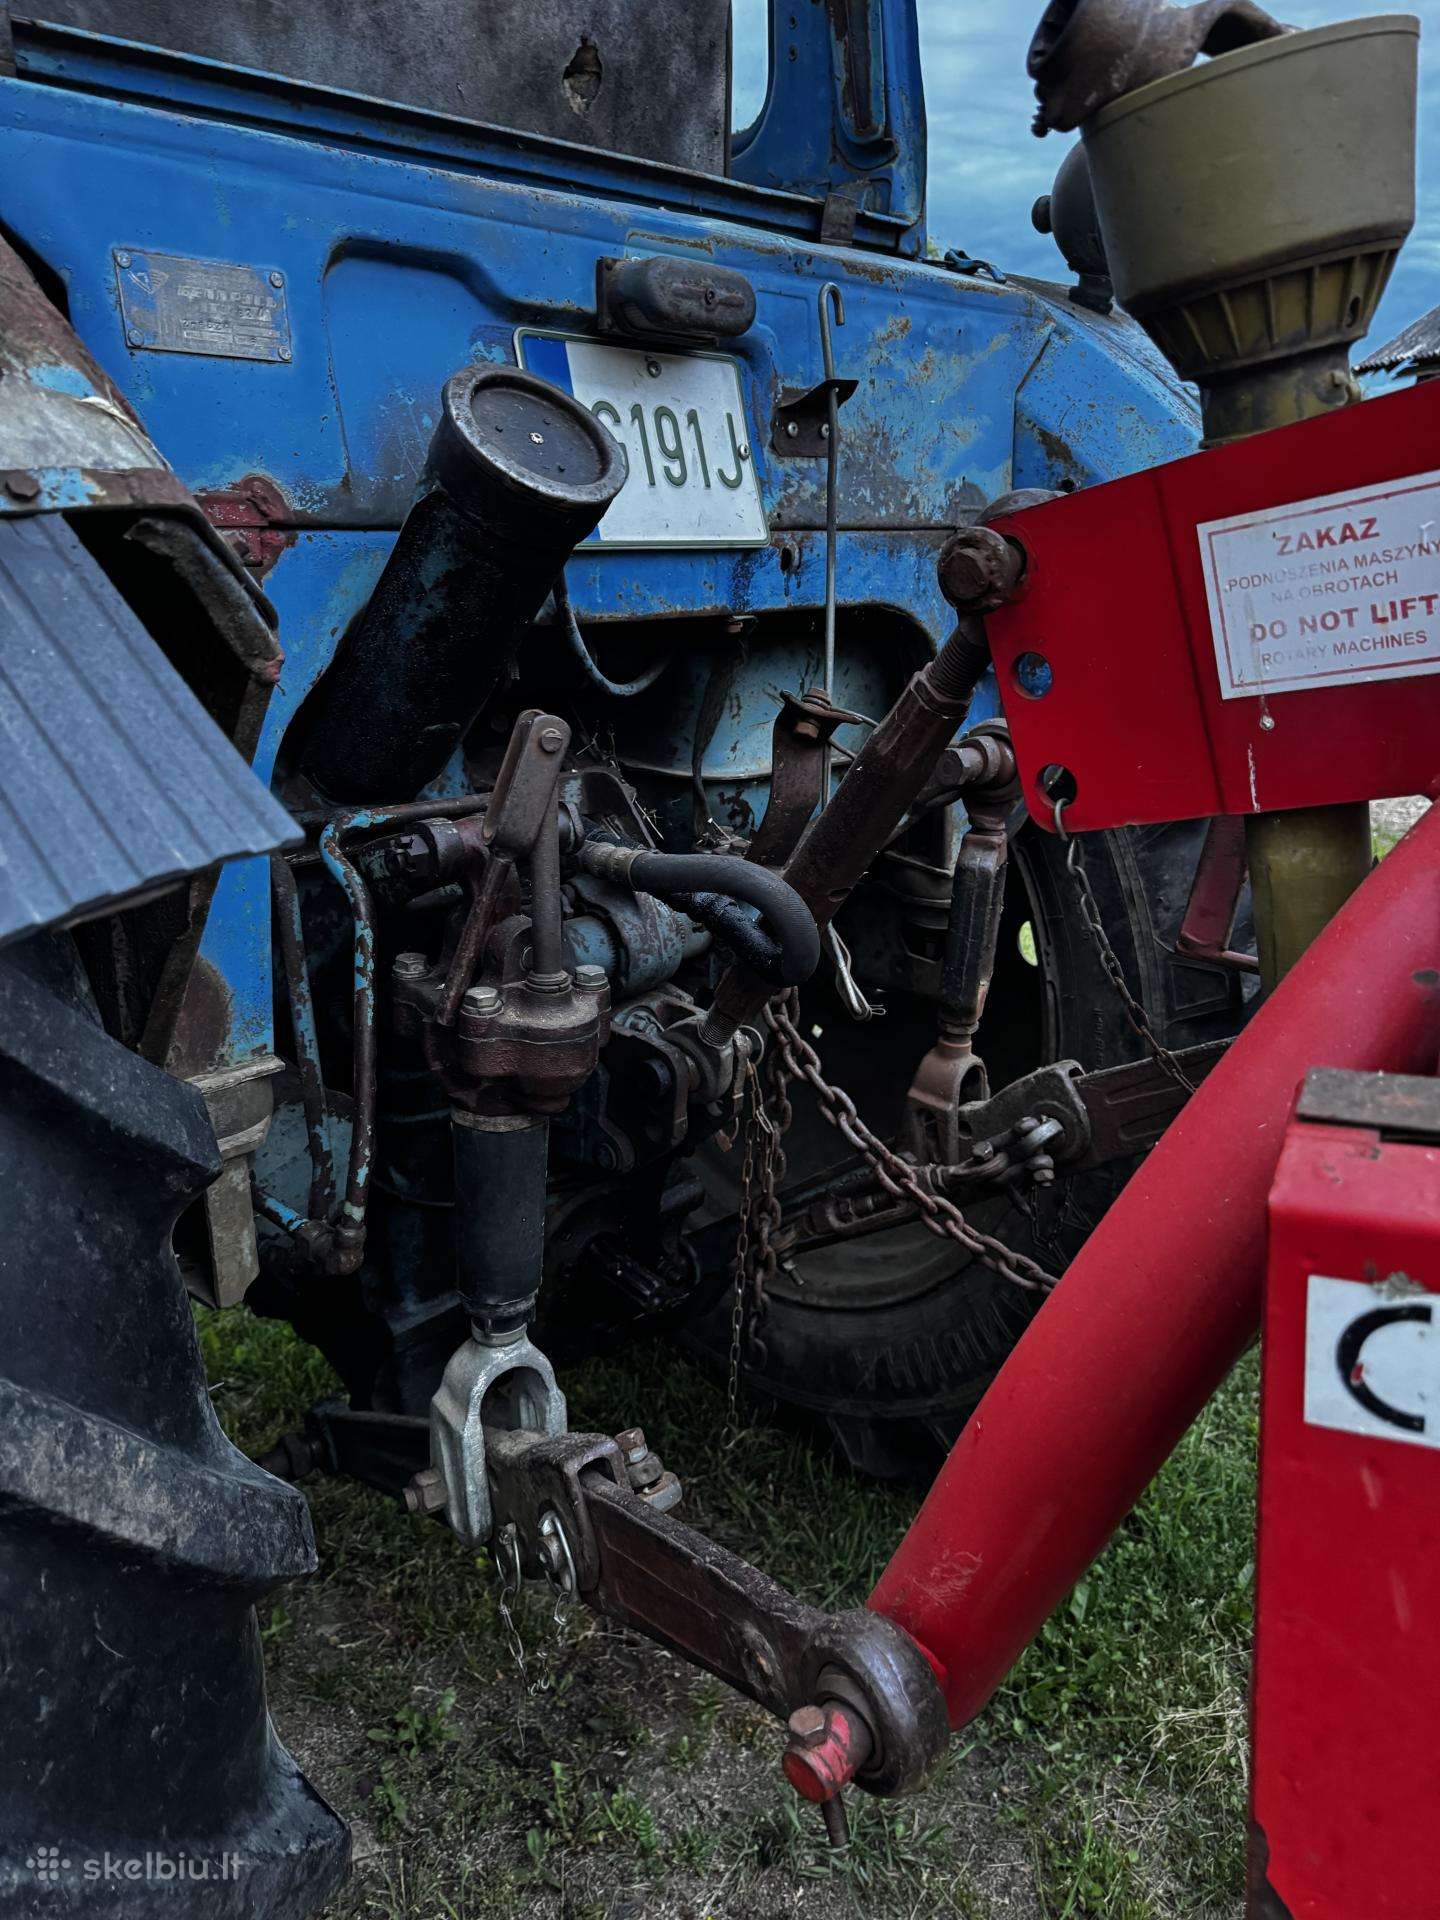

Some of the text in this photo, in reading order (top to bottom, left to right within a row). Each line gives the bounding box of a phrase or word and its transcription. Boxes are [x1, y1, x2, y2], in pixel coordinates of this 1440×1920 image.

[1275, 517, 1380, 556] ZAKAZ
[1227, 540, 1440, 592] PODNOSZENIA MASZYNY
[1271, 570, 1398, 604] NA OBROTACH
[1252, 594, 1439, 642] DO NOT LIFT
[1262, 630, 1428, 666] ROTARY MACHINES
